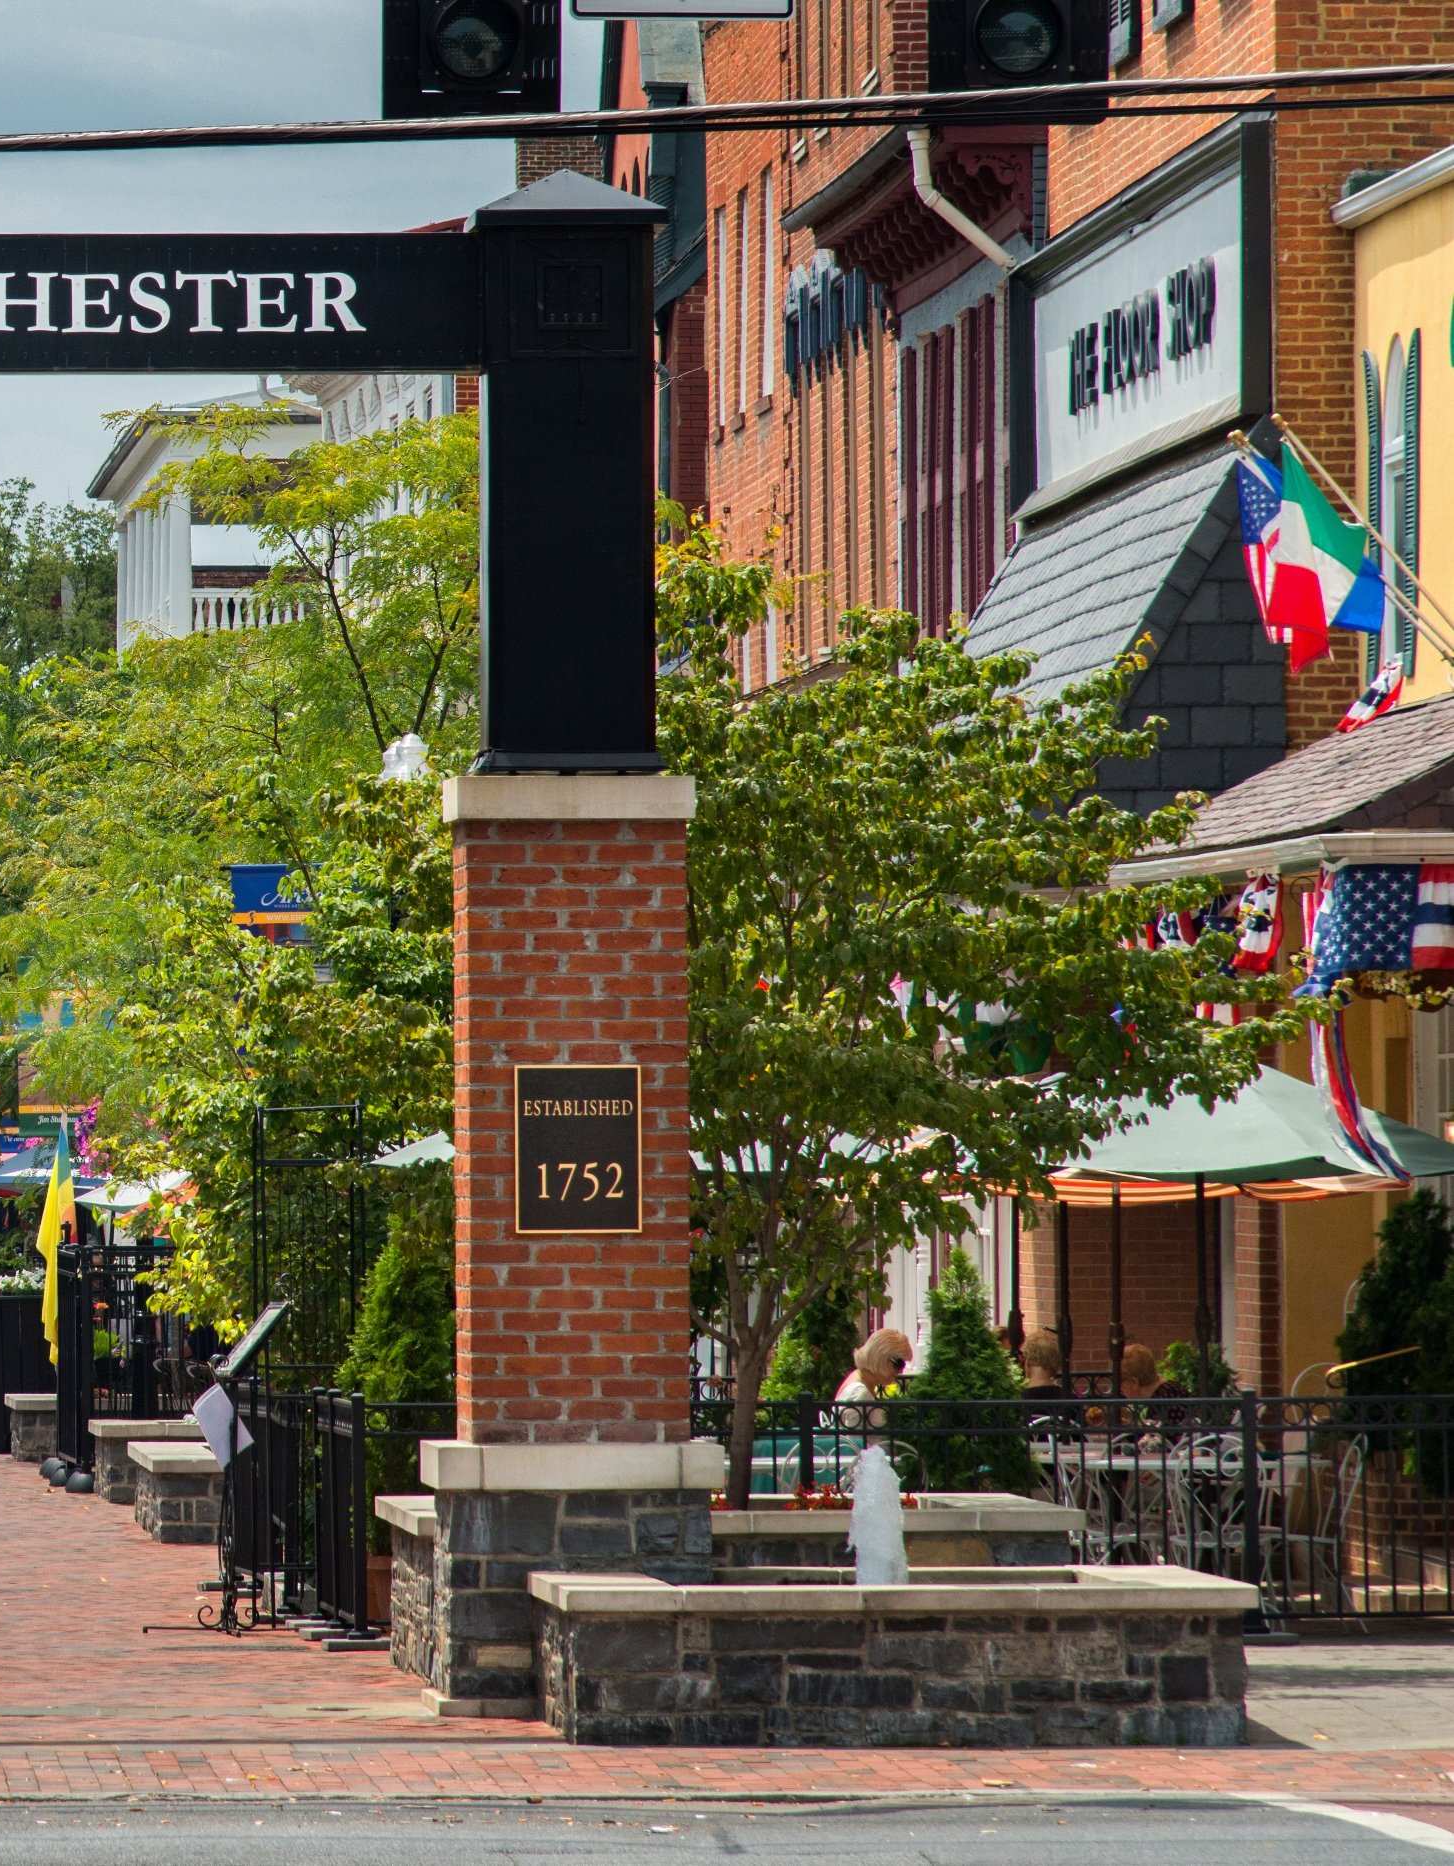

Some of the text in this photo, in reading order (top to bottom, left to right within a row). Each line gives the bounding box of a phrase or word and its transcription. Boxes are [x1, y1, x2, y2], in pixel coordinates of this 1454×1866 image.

[1069, 255, 1216, 416] THE FLOOR SHOP
[523, 1099, 634, 1117] ESTABLISHED
[537, 1162, 624, 1202] 1752
